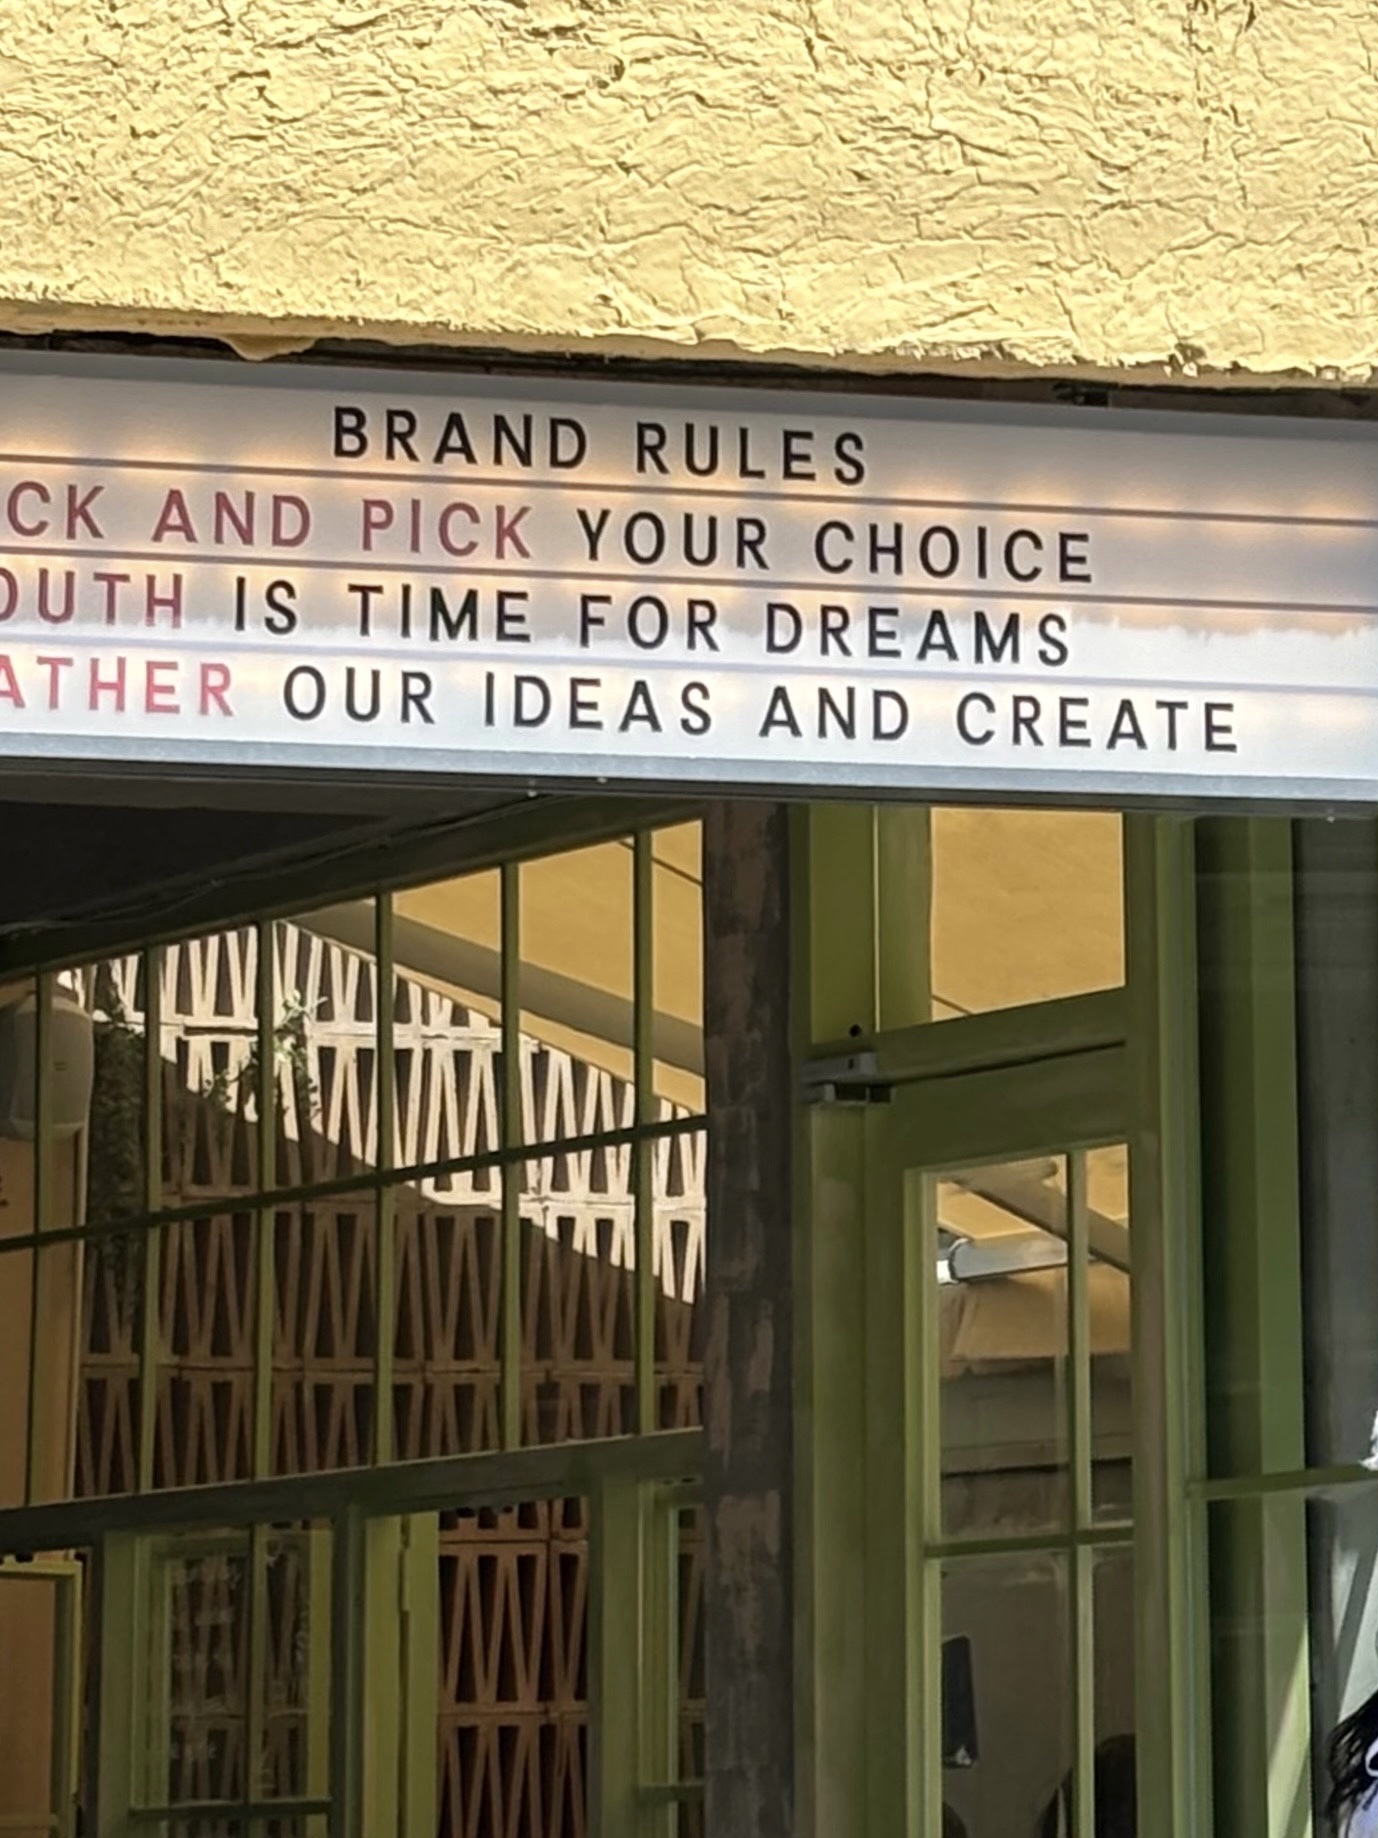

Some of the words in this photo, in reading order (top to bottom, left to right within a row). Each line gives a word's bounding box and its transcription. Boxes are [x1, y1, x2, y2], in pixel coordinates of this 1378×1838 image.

[334, 405, 588, 469] BRAND
[636, 422, 866, 485] RULES
[7, 480, 105, 540] CK
[151, 488, 312, 548] AND
[362, 498, 532, 559] PICK
[577, 508, 770, 570] YOUR
[814, 521, 1093, 583] CHOICE
[235, 576, 298, 636] IS
[348, 583, 531, 644] TIME
[579, 593, 720, 652] FOR
[766, 602, 1070, 666] DREAMS
[283, 664, 435, 725] OUR
[485, 671, 712, 736] IDEAS
[759, 685, 910, 742] AND
[956, 691, 1238, 753] CREATE
